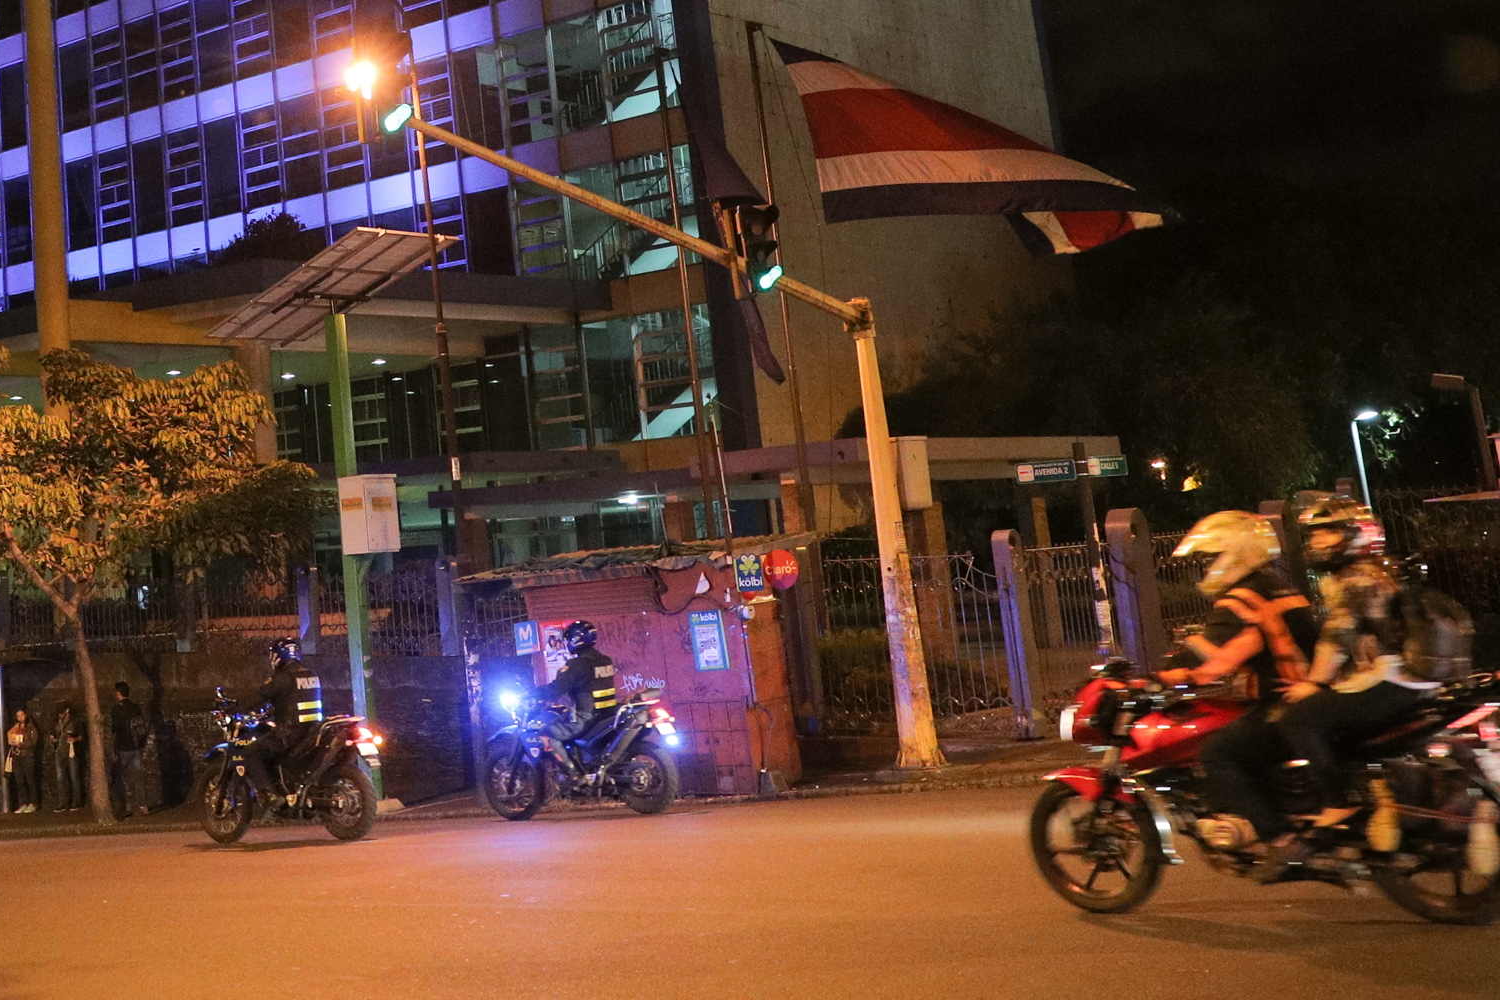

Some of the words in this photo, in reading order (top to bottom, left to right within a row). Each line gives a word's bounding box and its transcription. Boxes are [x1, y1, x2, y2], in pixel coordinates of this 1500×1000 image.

[1034, 467, 1062, 476] AVENIDA
[739, 577, 762, 587] kölbi
[700, 613, 718, 622] kölbi
